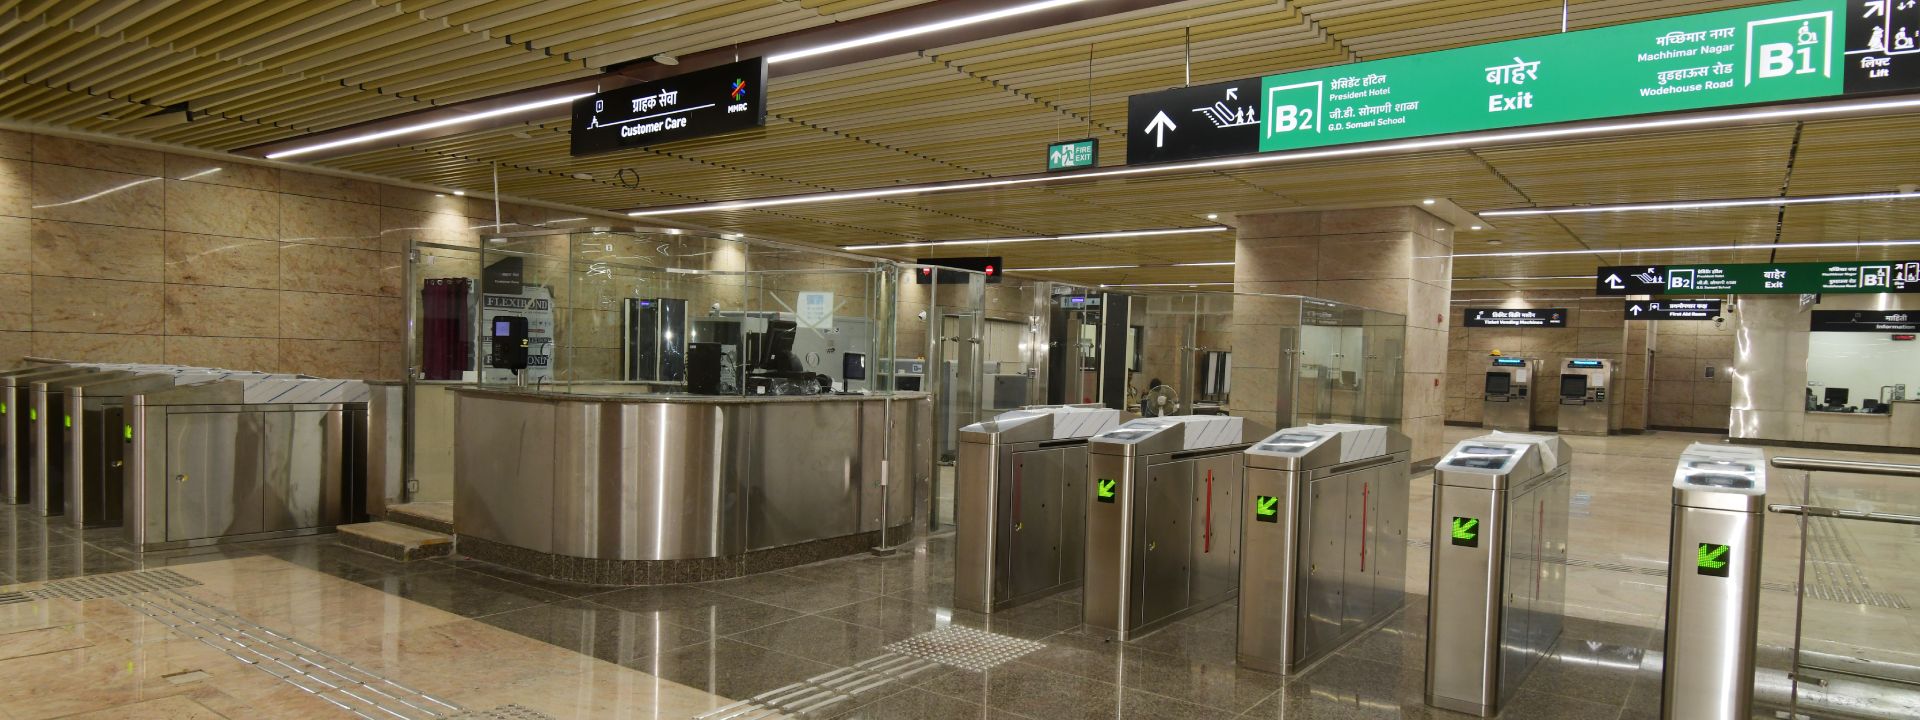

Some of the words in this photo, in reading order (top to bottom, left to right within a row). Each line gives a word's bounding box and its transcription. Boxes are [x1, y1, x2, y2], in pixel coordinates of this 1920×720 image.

[1656, 31, 1707, 46] मच्छिमार
[1709, 27, 1735, 39] नगर
[1637, 48, 1698, 62] Machhimar
[1700, 44, 1735, 55] Nagar
[1759, 42, 1816, 78] B1
[1485, 56, 1541, 85] बाहेर
[1657, 66, 1709, 85] वुडहाऊस
[1712, 61, 1734, 75] रोड
[1869, 69, 1890, 78] Lift
[1330, 76, 1360, 90] प्रेसिडेंट
[1362, 73, 1387, 87] हॉटेल
[1640, 84, 1702, 97] Wodehouse
[1705, 78, 1734, 90] Road
[631, 95, 657, 113] ग्राहक
[658, 88, 678, 107] सेवा
[1329, 90, 1367, 101] President
[1368, 86, 1391, 96] Hotel
[1488, 91, 1533, 112] Exit
[727, 102, 748, 114] MMRC
[1329, 106, 1356, 119] जी.डी.
[1358, 102, 1392, 116] सोमाणी
[1394, 101, 1419, 112] शाळा
[1275, 104, 1313, 133] B2
[1328, 122, 1344, 132] G.D.
[1345, 119, 1376, 130] Somani
[1377, 115, 1406, 126] School
[621, 121, 664, 138] Customer
[664, 117, 687, 130] Care
[1075, 146, 1092, 154] FIRE
[1075, 153, 1091, 161] EXIT
[1671, 276, 1690, 288] B2
[1763, 269, 1787, 280] बाहेर
[1864, 274, 1885, 287] B1
[1764, 281, 1783, 289] Exit
